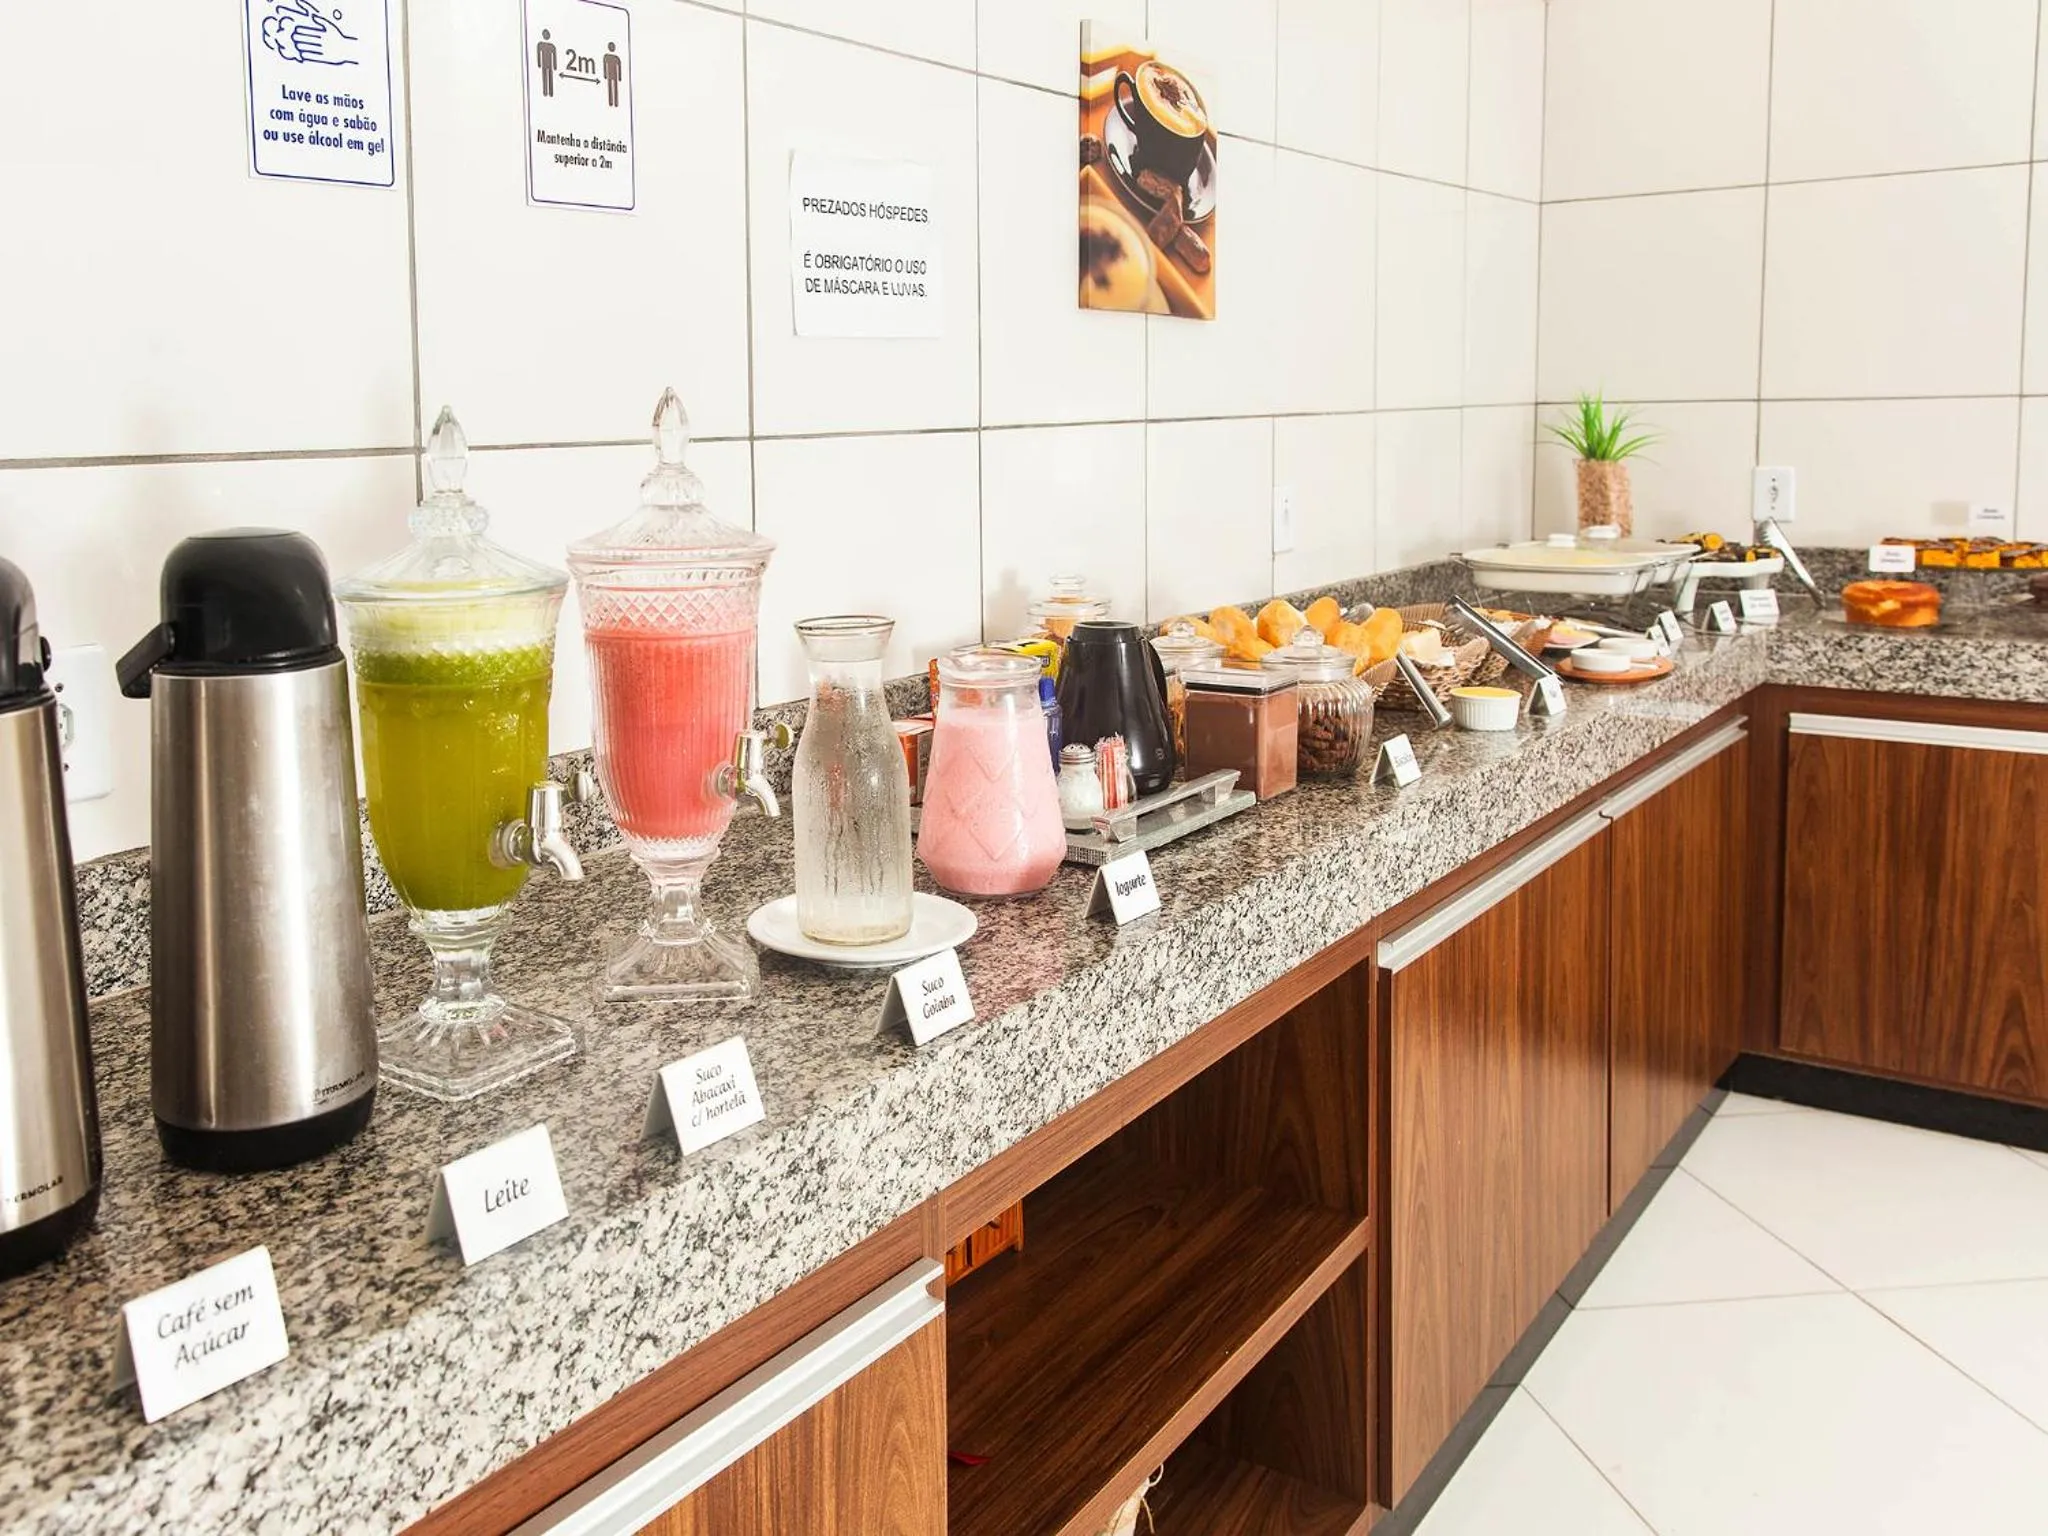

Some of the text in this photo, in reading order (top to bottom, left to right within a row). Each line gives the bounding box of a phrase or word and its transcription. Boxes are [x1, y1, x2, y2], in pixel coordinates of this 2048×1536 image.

[565, 48, 596, 75] 2m
[281, 83, 364, 110] Lave as mãos
[269, 108, 377, 132] com água e sabão
[262, 129, 384, 156] ou use álcool em gel
[536, 129, 627, 153] Mantenha a distância
[554, 152, 612, 169] superior a 2m
[802, 197, 867, 217] PREZADOS
[803, 249, 927, 275] É OBRIGATÓRIO O USO
[805, 277, 821, 293] DE
[824, 275, 880, 295] MÁSCARA
[881, 281, 890, 296] E
[1115, 874, 1146, 896] Iogurte
[921, 976, 945, 996] Suco
[922, 993, 956, 1020] Goiaba
[694, 1064, 722, 1085] Suco
[691, 1073, 737, 1107] Abacaxi
[484, 1178, 530, 1213] Leite
[157, 1283, 255, 1339] Café sem
[174, 1320, 250, 1371] Açúcar
